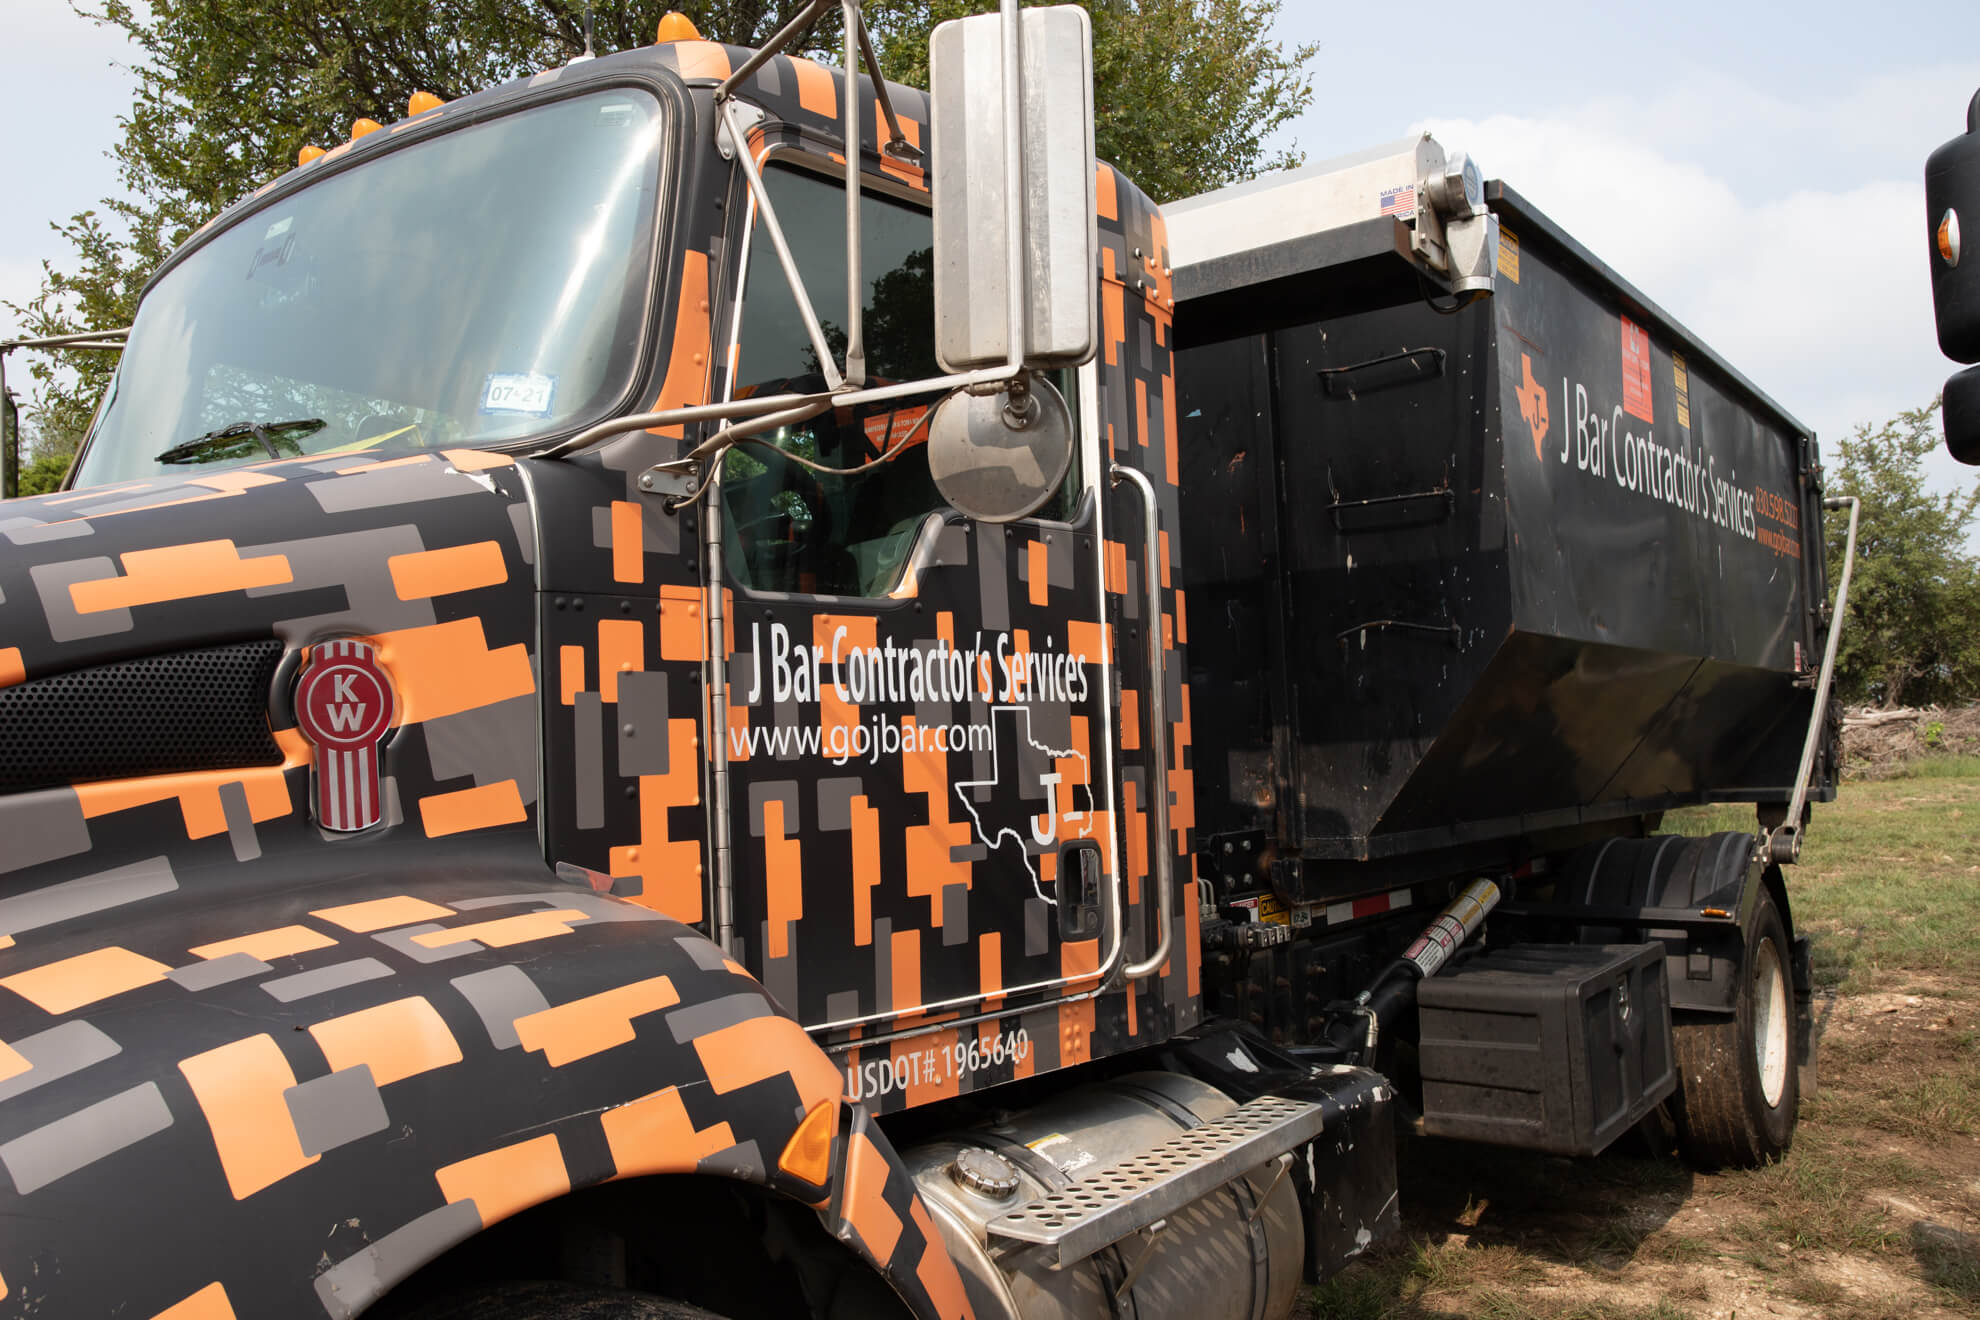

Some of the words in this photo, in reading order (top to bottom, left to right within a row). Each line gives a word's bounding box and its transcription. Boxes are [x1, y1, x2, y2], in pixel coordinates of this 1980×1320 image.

[1380, 186, 1403, 197] MADE
[1405, 183, 1414, 191] IN
[1560, 376, 1569, 464] J
[1575, 383, 1608, 478] Bar
[1612, 404, 1709, 519] Contractor's
[1709, 455, 1756, 540] Services
[748, 622, 762, 703] J
[770, 622, 824, 703] Bar
[832, 625, 992, 703] Contractor's
[997, 632, 1088, 703] Services
[730, 713, 992, 766] www.gojbar.com
[942, 1028, 1028, 1080] 1965640
